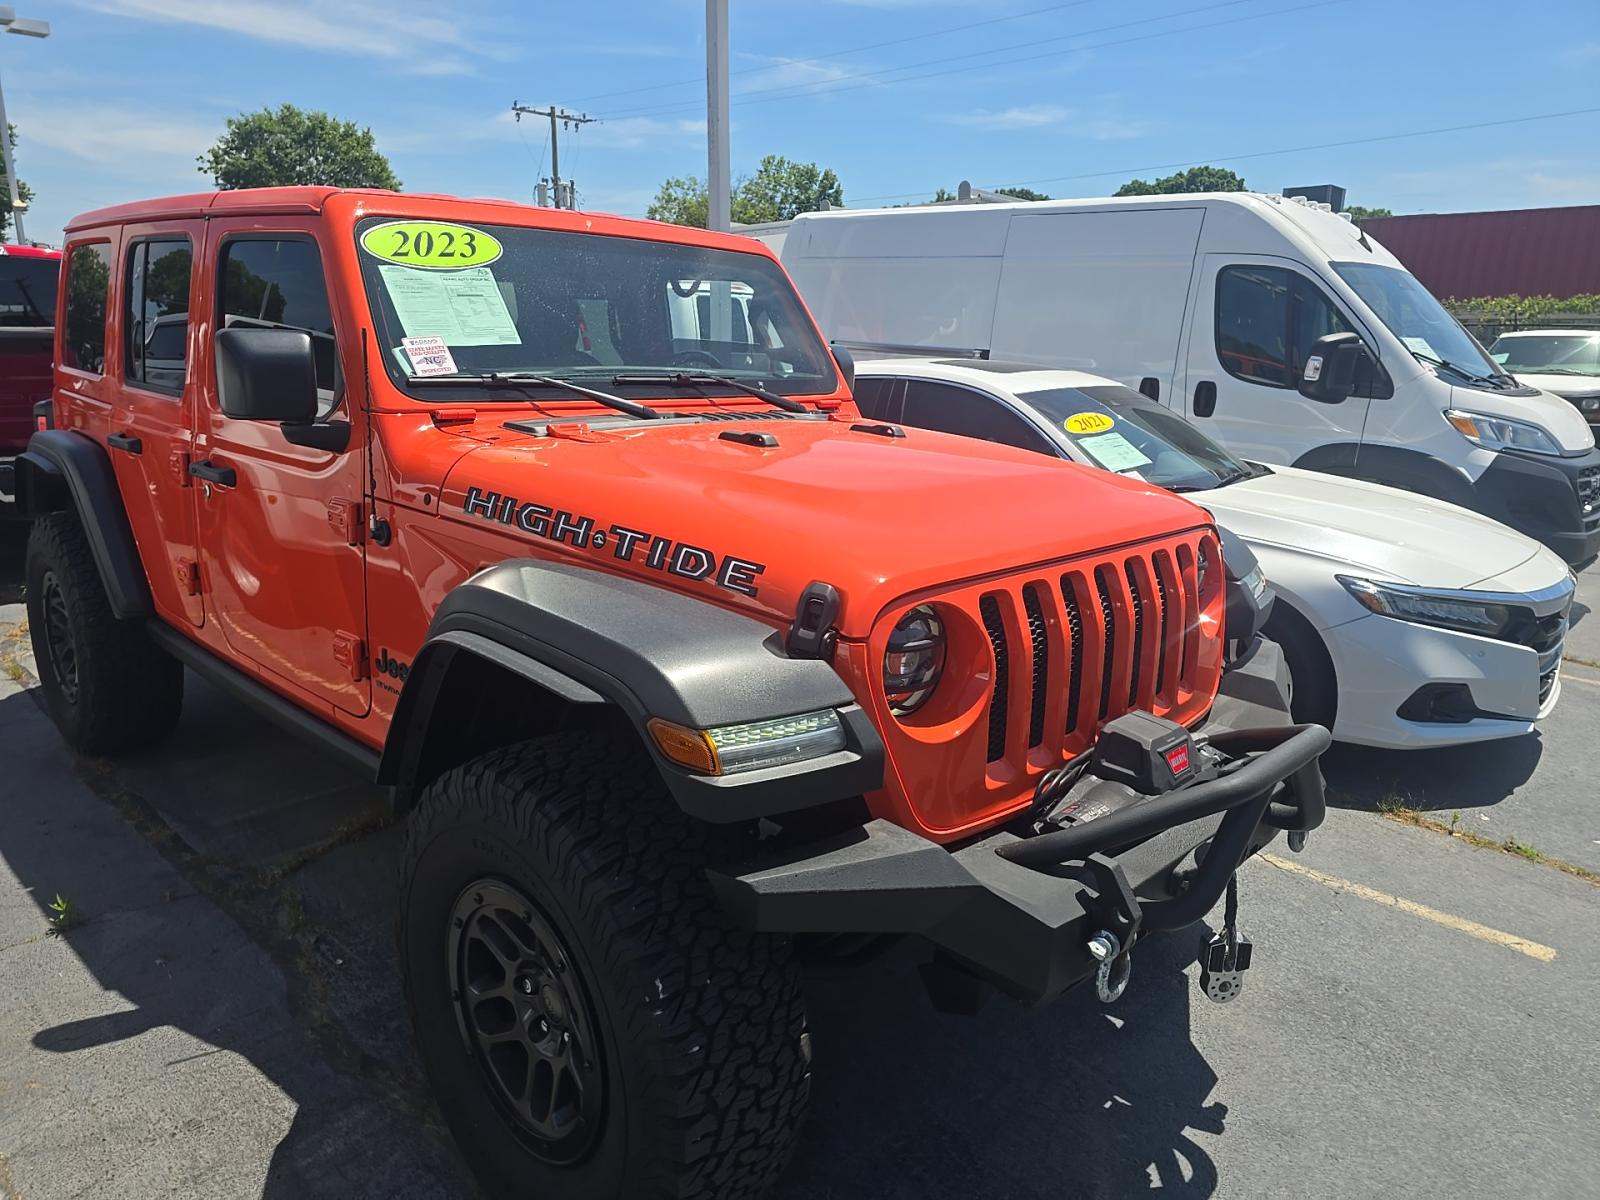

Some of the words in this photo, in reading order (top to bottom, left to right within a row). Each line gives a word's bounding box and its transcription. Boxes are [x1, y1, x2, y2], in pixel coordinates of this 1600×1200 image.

[390, 230, 477, 258] 2023
[424, 356, 441, 365] NC
[463, 486, 595, 549] HIGH
[608, 524, 767, 597] TIDE
[375, 647, 411, 682] Jee
